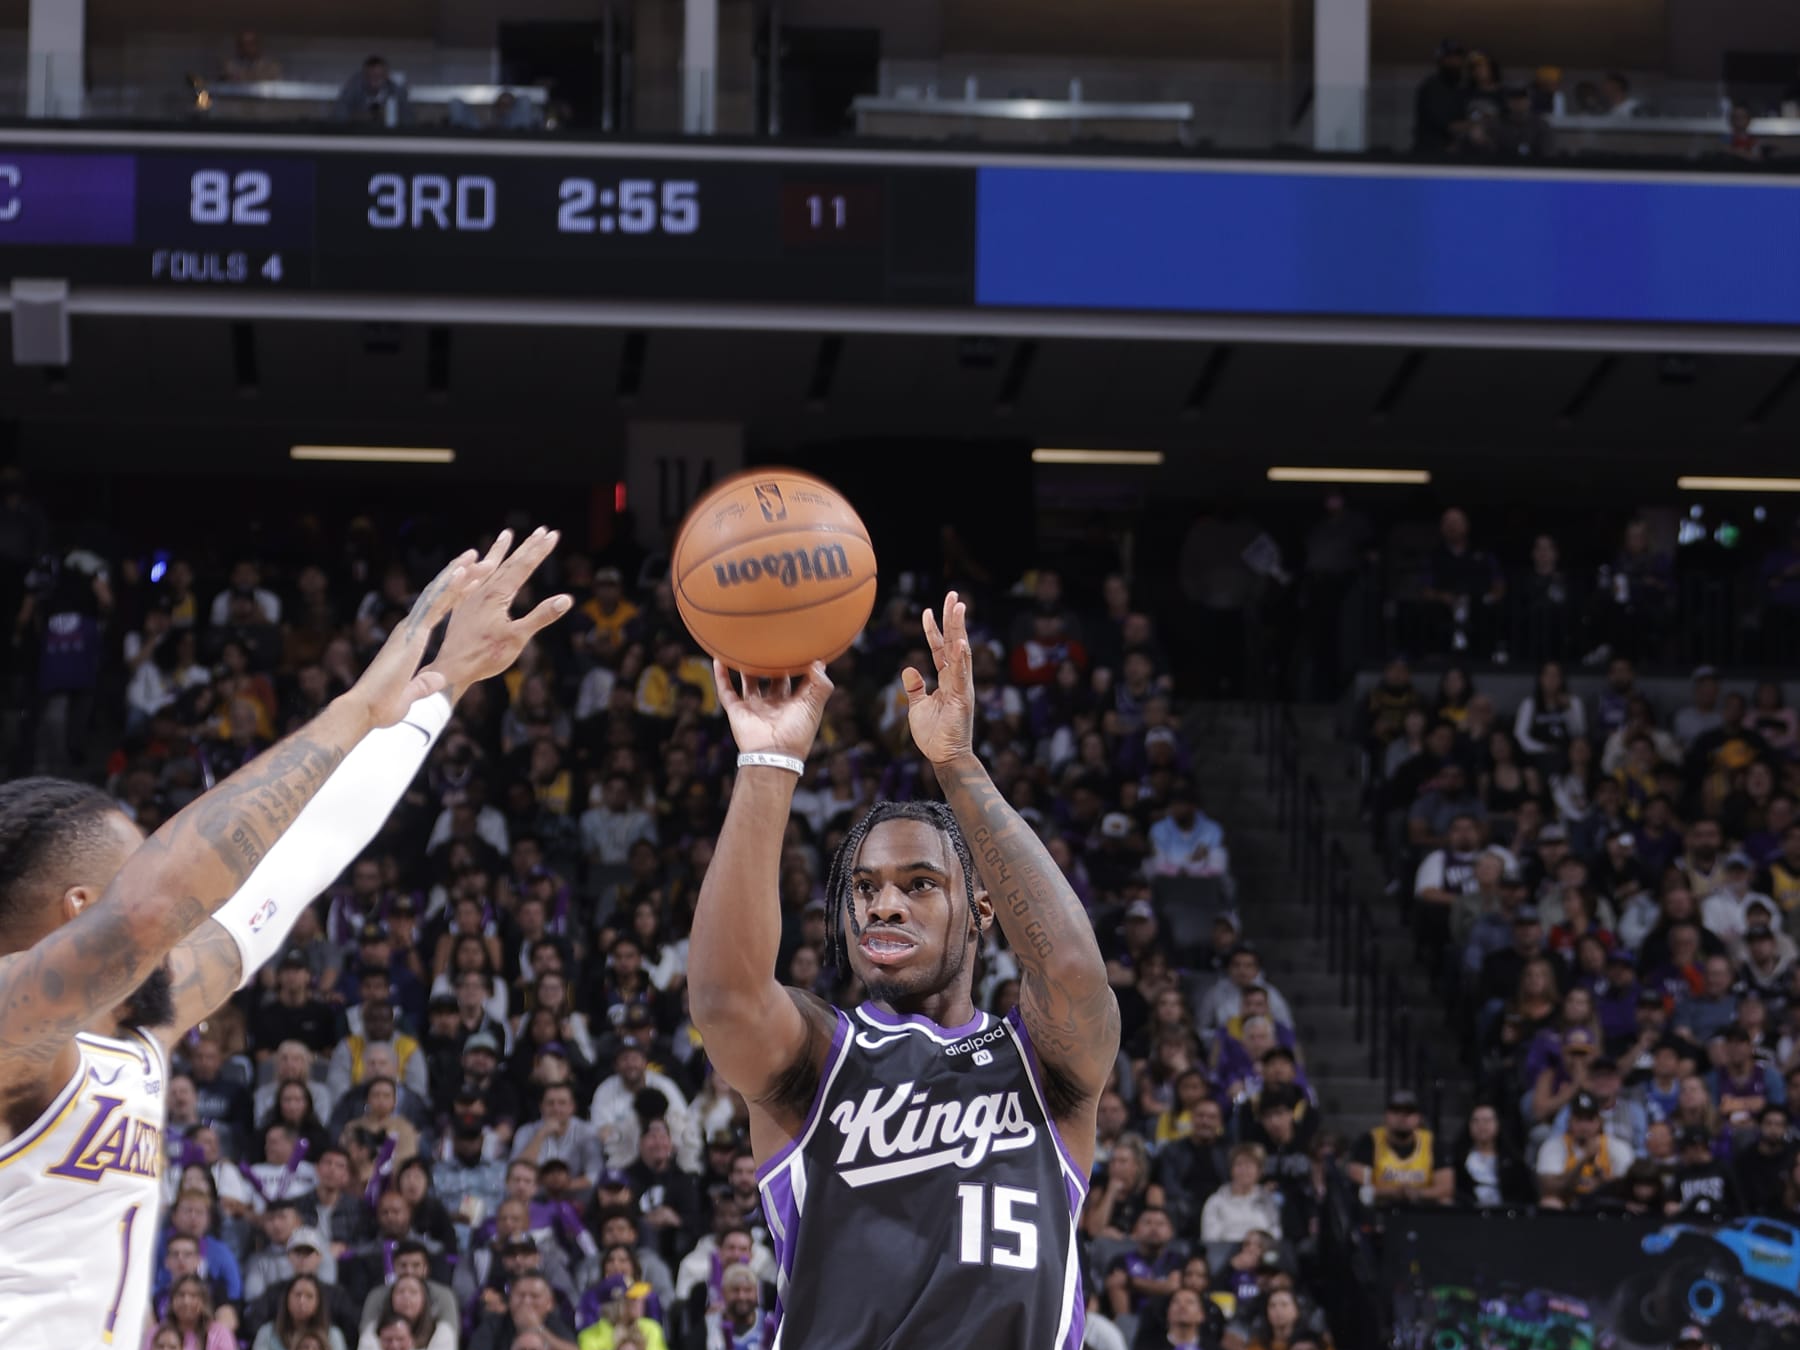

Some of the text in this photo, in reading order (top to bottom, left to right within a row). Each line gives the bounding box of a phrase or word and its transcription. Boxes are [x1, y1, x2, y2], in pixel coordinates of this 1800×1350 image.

[189, 168, 272, 226] 82
[367, 173, 497, 231] 3RD
[557, 177, 701, 234] 2:55
[807, 194, 848, 229] 11
[151, 250, 283, 282] FOULS 4
[713, 542, 852, 589] Wilson
[945, 1025, 1006, 1057] dialpad
[829, 1080, 1036, 1188] Kings
[957, 1182, 1039, 1270] 15
[103, 1201, 140, 1344] 1
